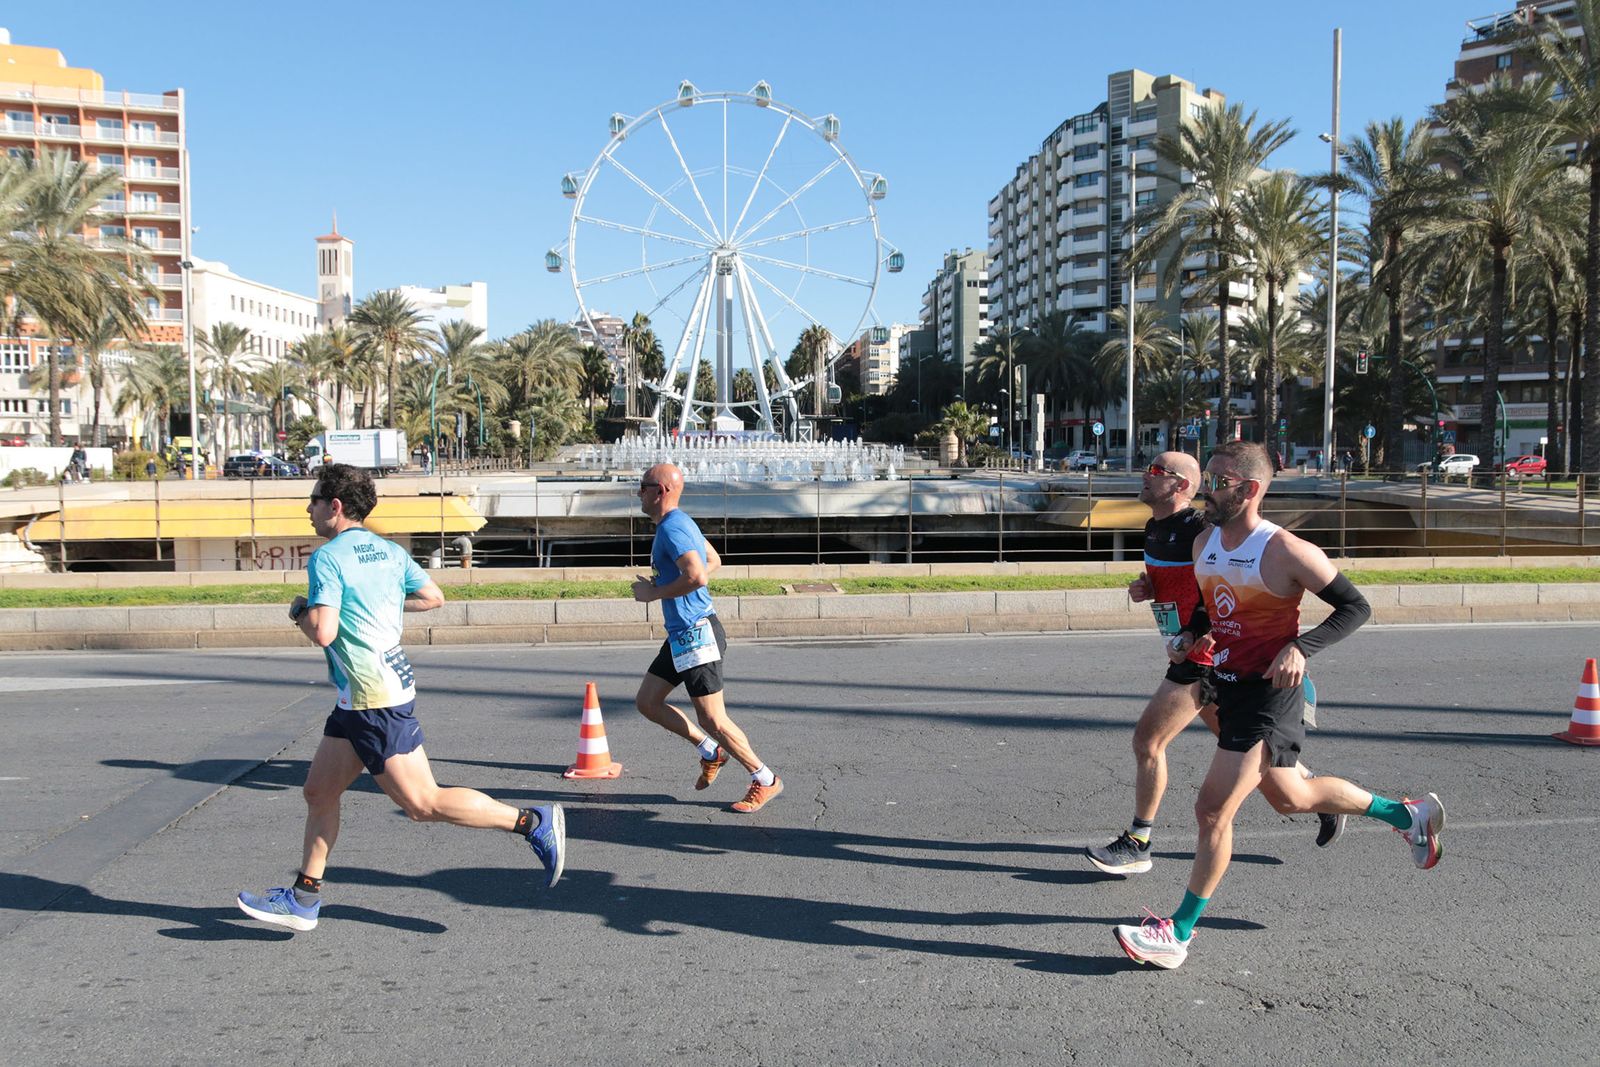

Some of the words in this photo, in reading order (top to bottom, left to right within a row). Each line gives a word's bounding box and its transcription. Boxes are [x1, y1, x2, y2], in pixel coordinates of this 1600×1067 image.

[353, 543, 375, 554] MEDIO
[358, 550, 389, 564] MARATÓN
[1153, 611, 1169, 626] 47
[678, 627, 703, 646] 637
